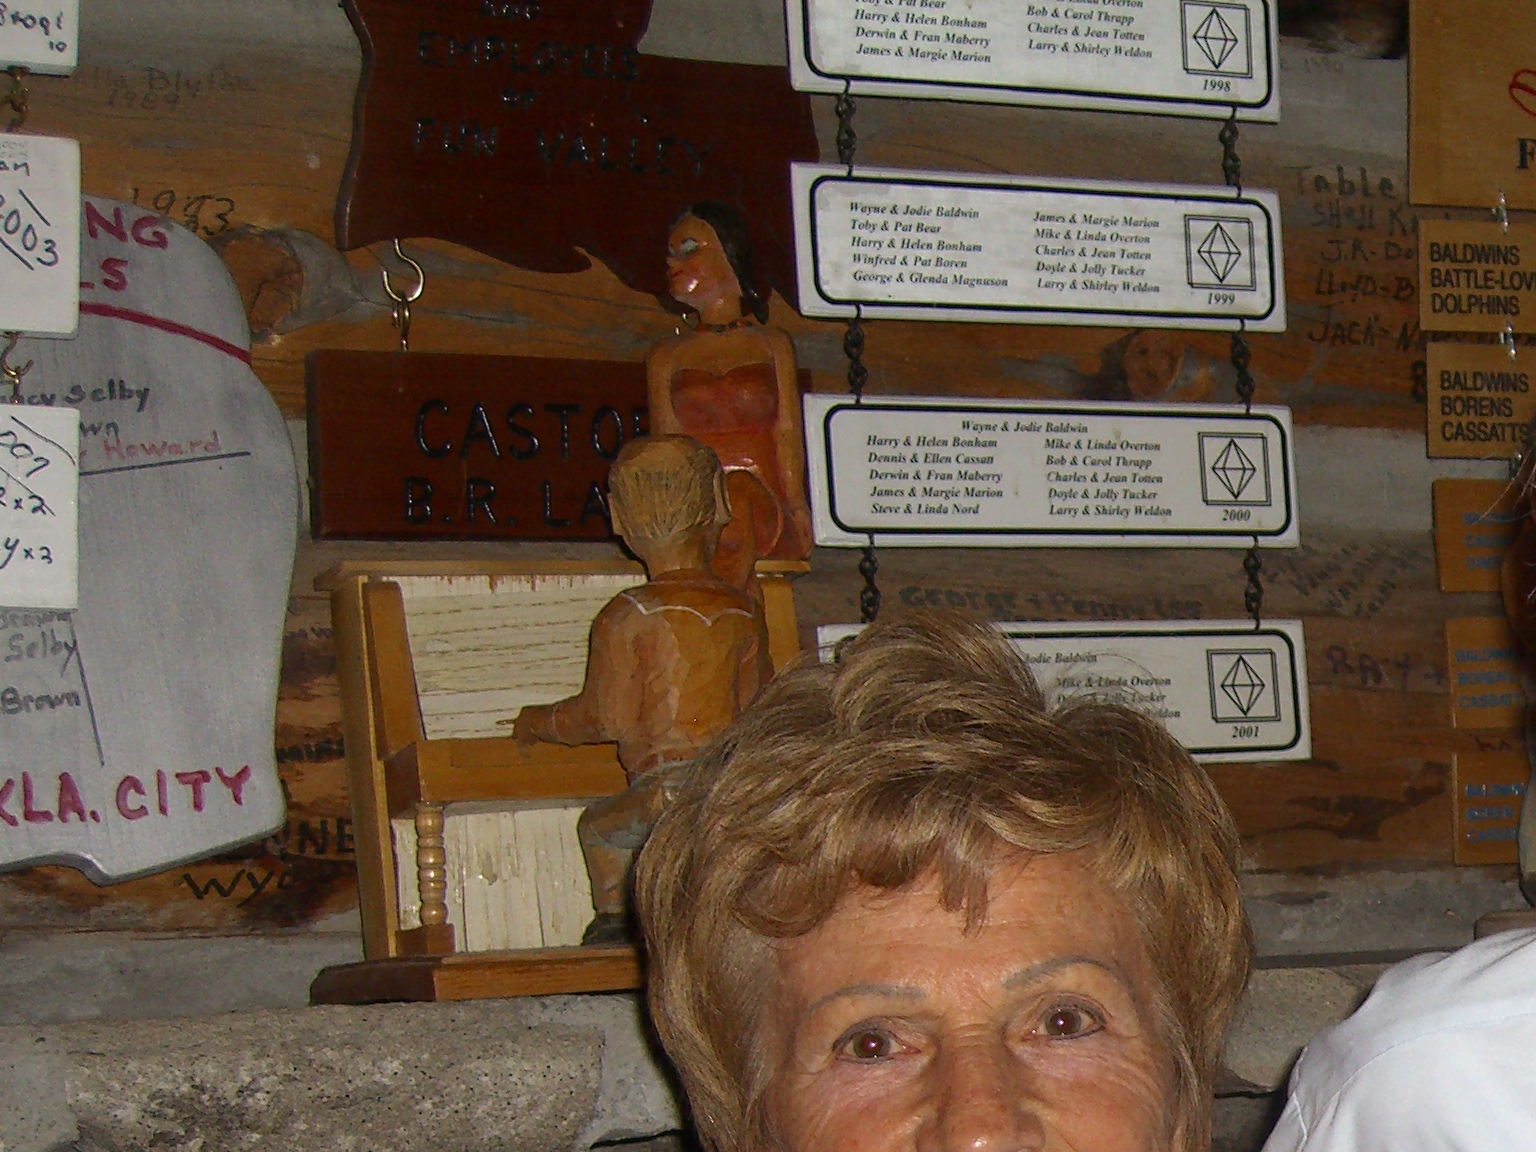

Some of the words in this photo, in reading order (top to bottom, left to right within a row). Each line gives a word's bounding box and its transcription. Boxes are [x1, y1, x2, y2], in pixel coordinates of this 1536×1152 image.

[418, 31, 638, 80] EMPLOYEES
[1204, 79, 1232, 92] 1998
[414, 117, 496, 157] FUN
[535, 129, 714, 175] VALLEY
[849, 202, 887, 216] Wayne
[890, 204, 899, 215] &
[903, 205, 933, 217] Jodie
[936, 206, 979, 219] Baldwin
[850, 219, 878, 233] Toby
[880, 221, 889, 232] &
[894, 221, 913, 233] Pat
[916, 222, 942, 234] Bear
[851, 236, 884, 250] Harry
[887, 238, 896, 249] &
[901, 238, 933, 251] Helen
[937, 240, 982, 253] Bonham
[852, 253, 896, 267] Winfred
[900, 255, 908, 266] &
[913, 256, 933, 268] Pat
[936, 257, 968, 269] Boren
[1430, 242, 1520, 266] BALDWINS
[853, 270, 893, 285] George
[896, 272, 905, 283] &
[909, 272, 948, 285] Glenda
[951, 274, 1008, 289] Magnuson
[1208, 292, 1235, 305] 1999
[1431, 293, 1520, 316] DOLPHINS
[1440, 370, 1530, 393] BALDWINS
[1440, 395, 1513, 417] BORENS
[961, 420, 998, 434] Wayne
[1000, 421, 1010, 432] &
[1013, 421, 1042, 433] Jodie
[1045, 422, 1088, 434] Baldwin
[866, 435, 900, 450] Harry
[903, 437, 913, 448] &
[916, 437, 949, 448] Helen
[952, 437, 998, 449] Bonham
[1045, 438, 1072, 450] Mike
[1074, 439, 1083, 450] &
[1086, 439, 1117, 451] Linda
[1120, 440, 1161, 452] Overton
[867, 452, 906, 464] Dennis
[909, 453, 919, 464] &
[923, 453, 952, 464] Ellen
[1046, 455, 1067, 467] Bob
[1070, 456, 1079, 467] &
[1082, 456, 1113, 467] Carol
[1116, 456, 1152, 470] Thrapp
[869, 469, 910, 481] Derwin
[913, 470, 922, 481] &
[927, 470, 953, 481] Fran
[956, 470, 1003, 484] Maberry
[1047, 472, 1087, 484] Charles
[1090, 473, 1099, 484] &
[1102, 473, 1127, 484] Jean
[1130, 473, 1163, 485] Totten
[870, 486, 905, 498] James
[907, 487, 917, 498] &
[921, 487, 960, 500] Margie
[962, 487, 1003, 499] Marion
[1048, 488, 1078, 501] Doyle
[1080, 489, 1090, 500] &
[1093, 489, 1120, 502] Jolly
[1122, 489, 1158, 501] Tucker
[870, 503, 900, 515] Steve
[904, 504, 913, 515] &
[917, 503, 949, 515] Linda
[952, 504, 980, 515] Nord
[1049, 504, 1078, 518] Larry
[1081, 505, 1090, 516] &
[1094, 505, 1130, 518] Shirley
[1133, 506, 1172, 518] Weldon
[1222, 509, 1251, 521] 2000
[1232, 726, 1260, 738] 2001
[116, 765, 251, 820] CITY
